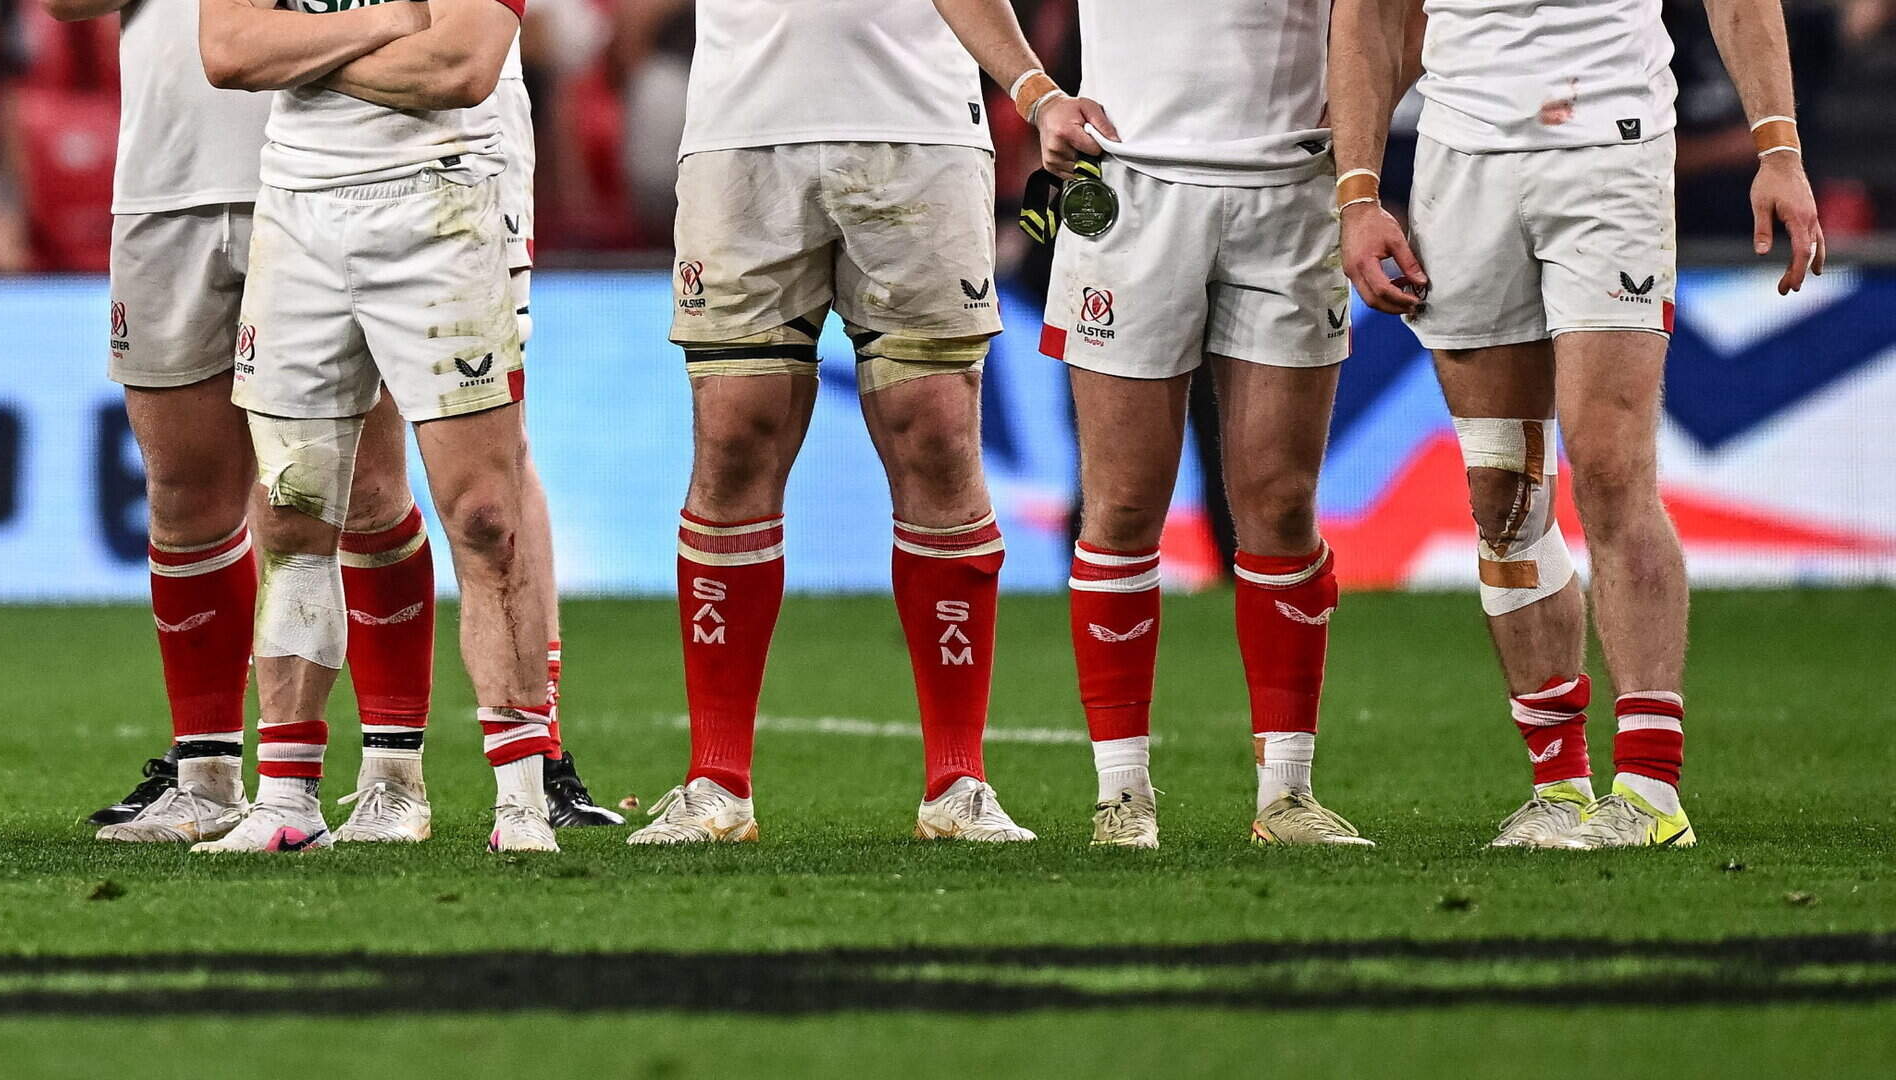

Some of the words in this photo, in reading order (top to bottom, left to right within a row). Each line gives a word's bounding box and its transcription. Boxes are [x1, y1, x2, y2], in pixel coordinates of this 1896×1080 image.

[110, 340, 129, 351] LSTER
[1076, 323, 1115, 340] ULSTER
[692, 576, 727, 645] SAM
[935, 600, 974, 666] SAM
